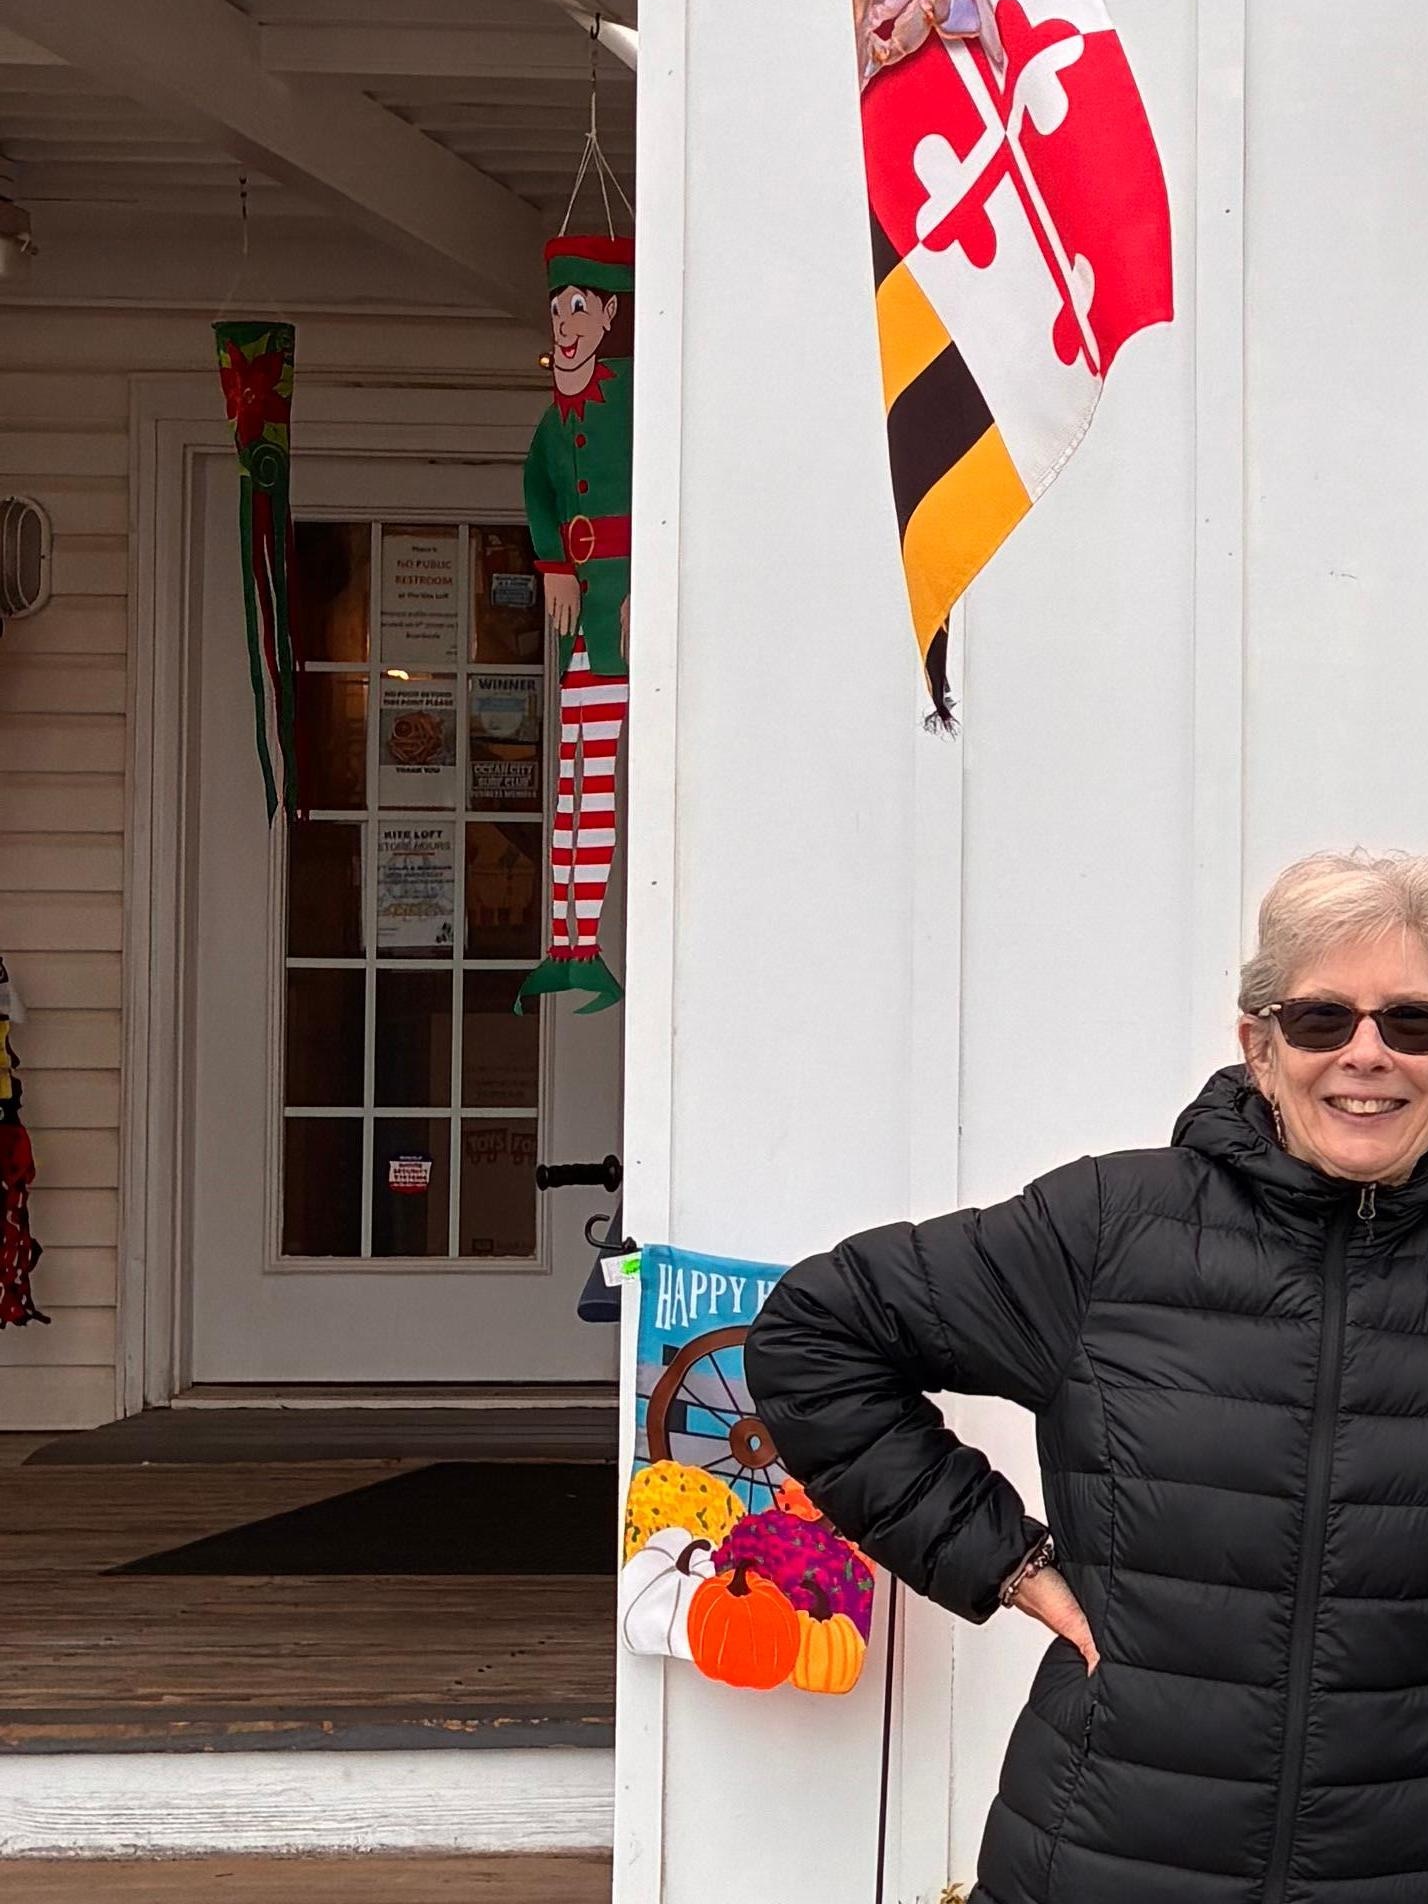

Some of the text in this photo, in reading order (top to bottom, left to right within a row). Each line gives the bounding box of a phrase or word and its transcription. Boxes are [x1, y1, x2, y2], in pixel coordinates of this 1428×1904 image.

[478, 678, 536, 691] WINNER
[384, 830, 444, 839] KITE LOFT
[655, 1263, 747, 1330] HAPPY
